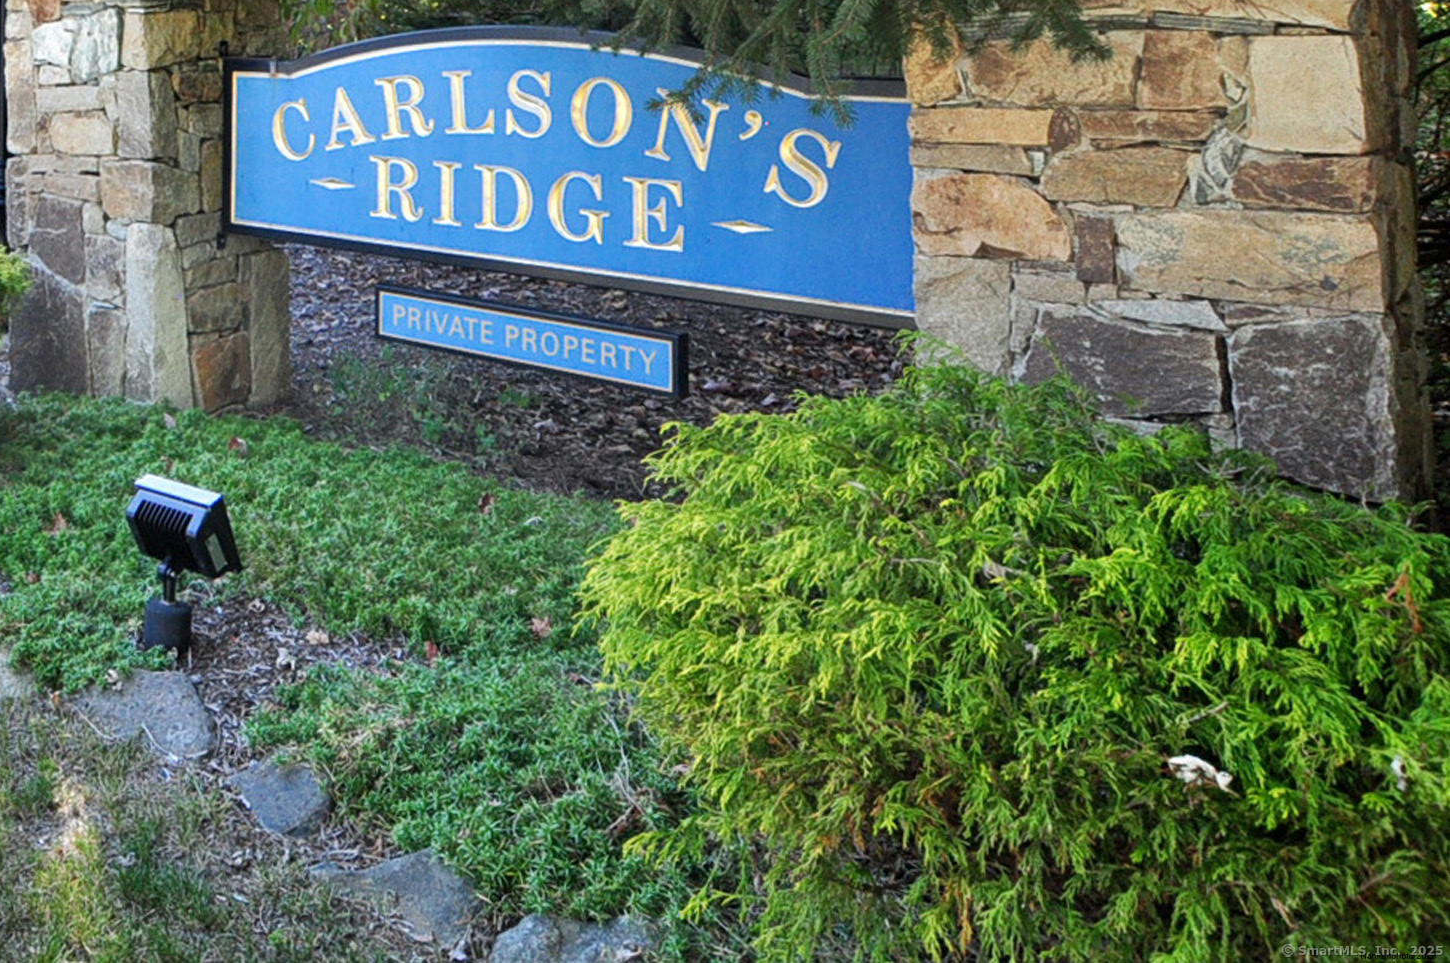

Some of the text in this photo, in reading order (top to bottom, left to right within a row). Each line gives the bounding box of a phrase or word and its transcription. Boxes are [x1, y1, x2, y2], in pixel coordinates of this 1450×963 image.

[271, 69, 842, 209] CARLSON'S
[369, 154, 685, 253] RIDGE
[391, 303, 657, 375] PRIVATE PROPERTY
